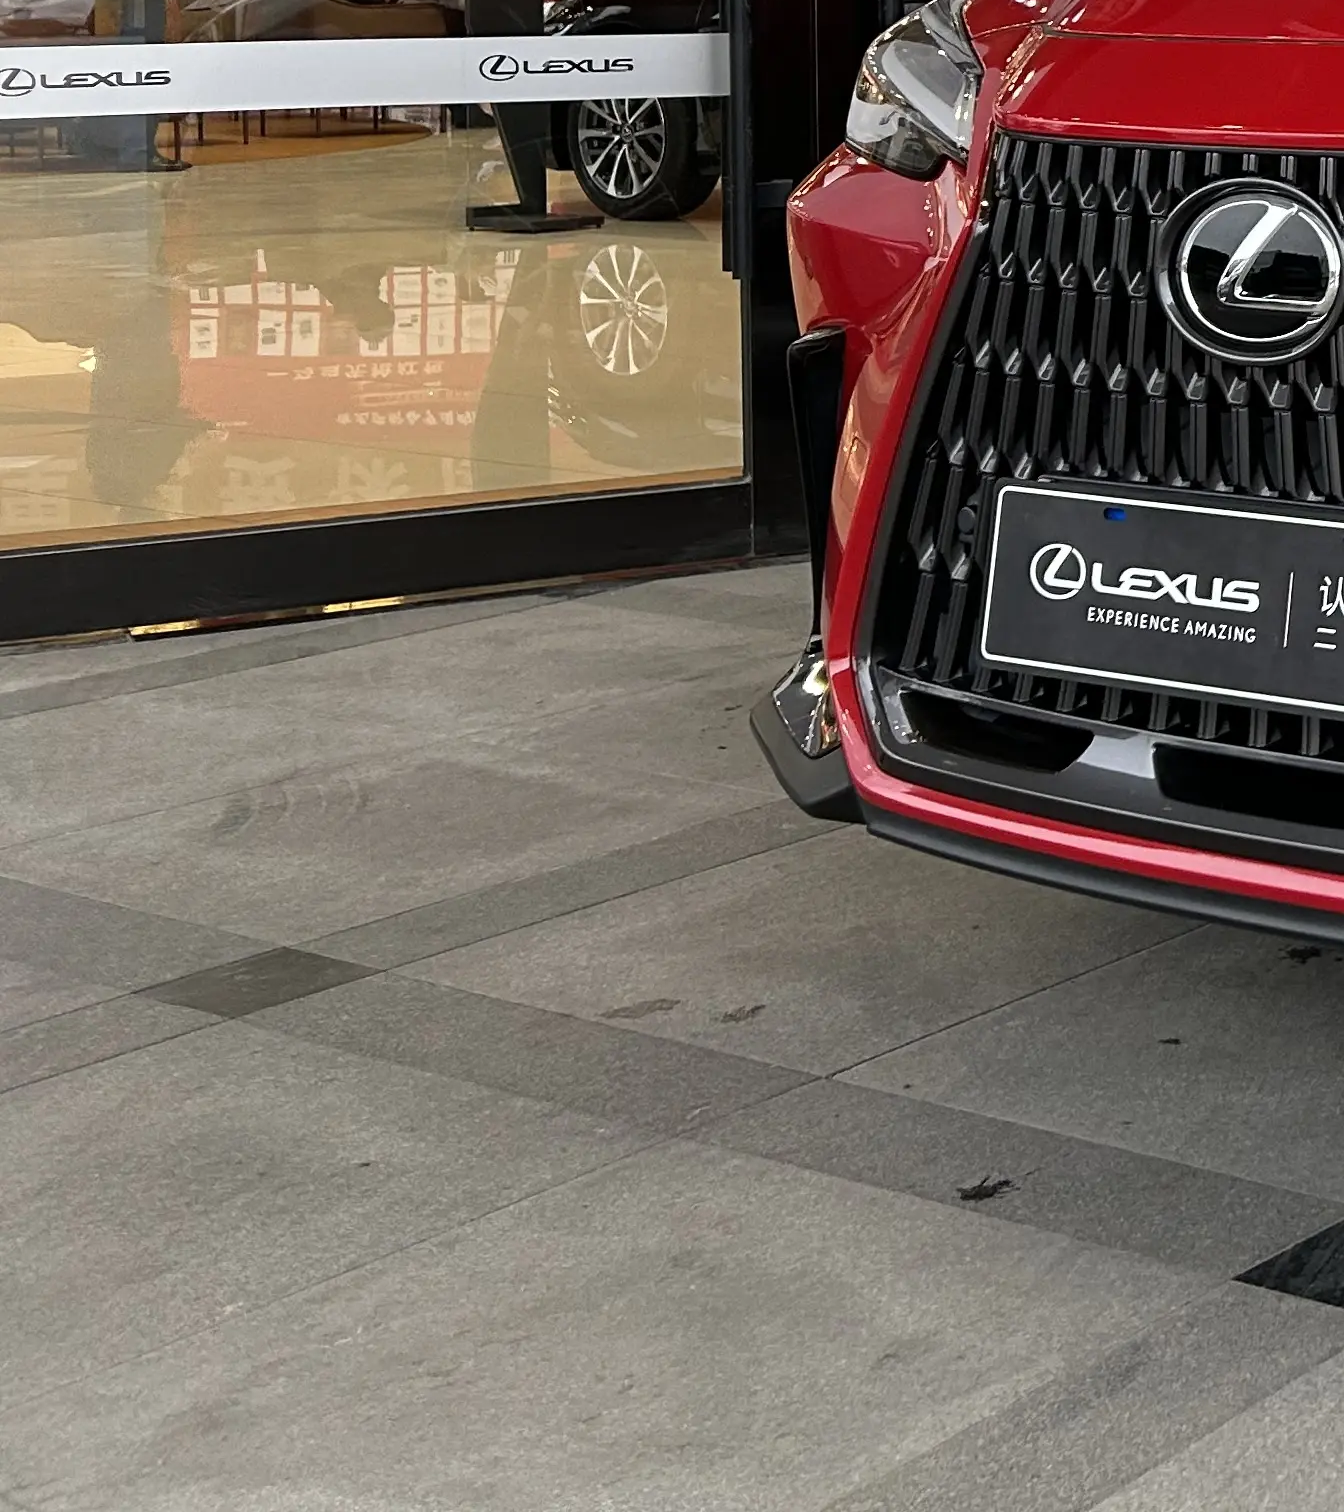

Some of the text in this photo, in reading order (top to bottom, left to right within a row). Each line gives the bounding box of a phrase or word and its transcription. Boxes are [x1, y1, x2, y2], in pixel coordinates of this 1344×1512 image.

[40, 70, 172, 89] LEXUS
[523, 56, 634, 74] LEXUS
[1090, 560, 1261, 614] LEXUS
[1086, 605, 1257, 645] EXPERIENCE AMAZING
